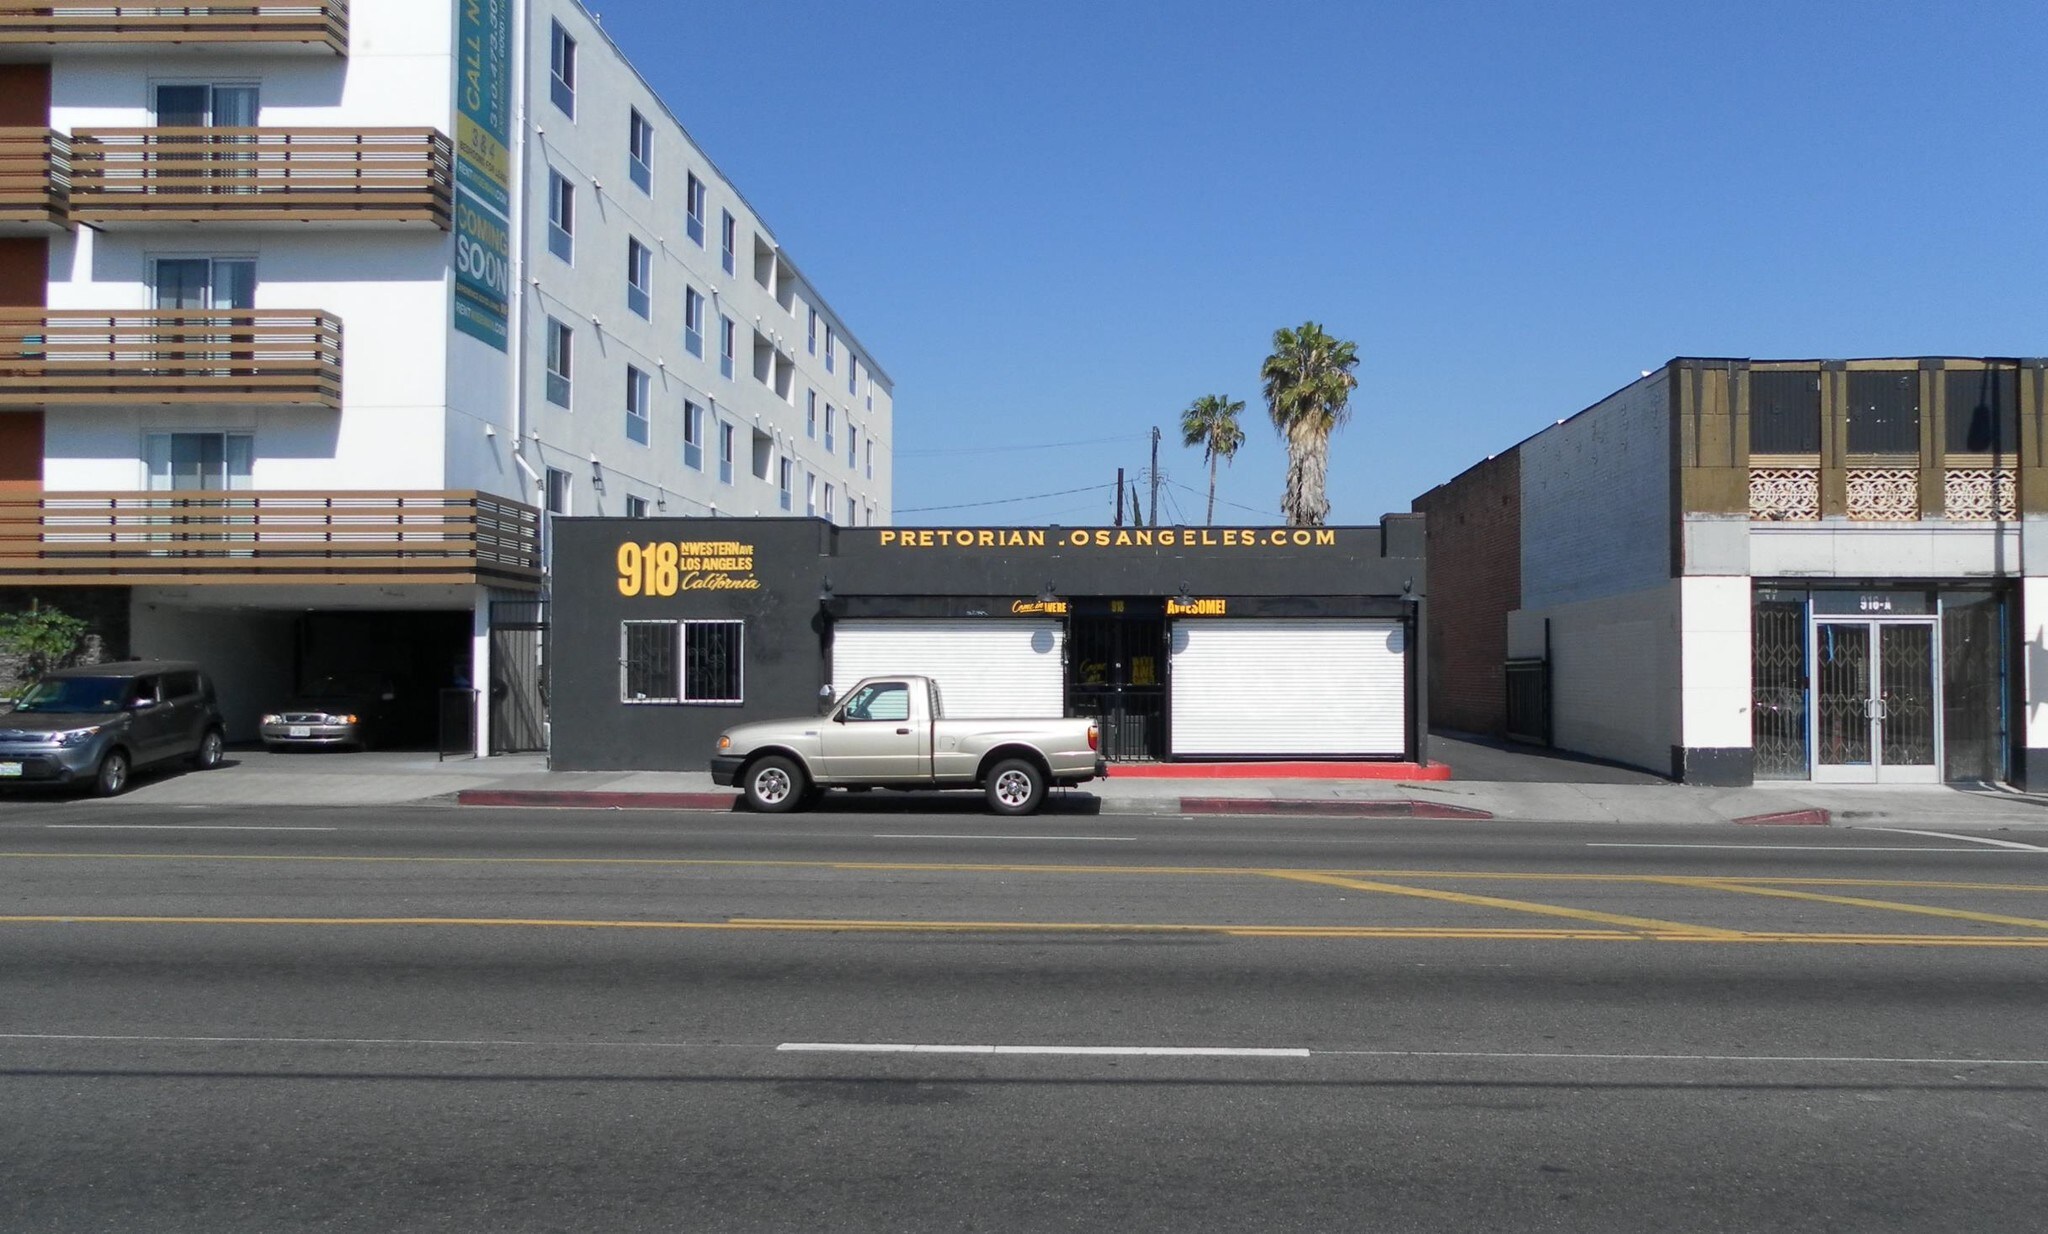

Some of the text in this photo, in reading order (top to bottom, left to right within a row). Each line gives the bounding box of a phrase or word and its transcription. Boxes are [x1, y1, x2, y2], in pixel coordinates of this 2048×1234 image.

[467, 36, 481, 111] CALL
[459, 203, 509, 257] COMING
[457, 234, 509, 296] SOON
[689, 542, 740, 555] WESTERN
[880, 530, 1336, 546] PRETORIAN OSANGELES.COM
[618, 541, 679, 597] 918
[681, 557, 753, 571] LOS ANGELES
[682, 571, 762, 591] California
